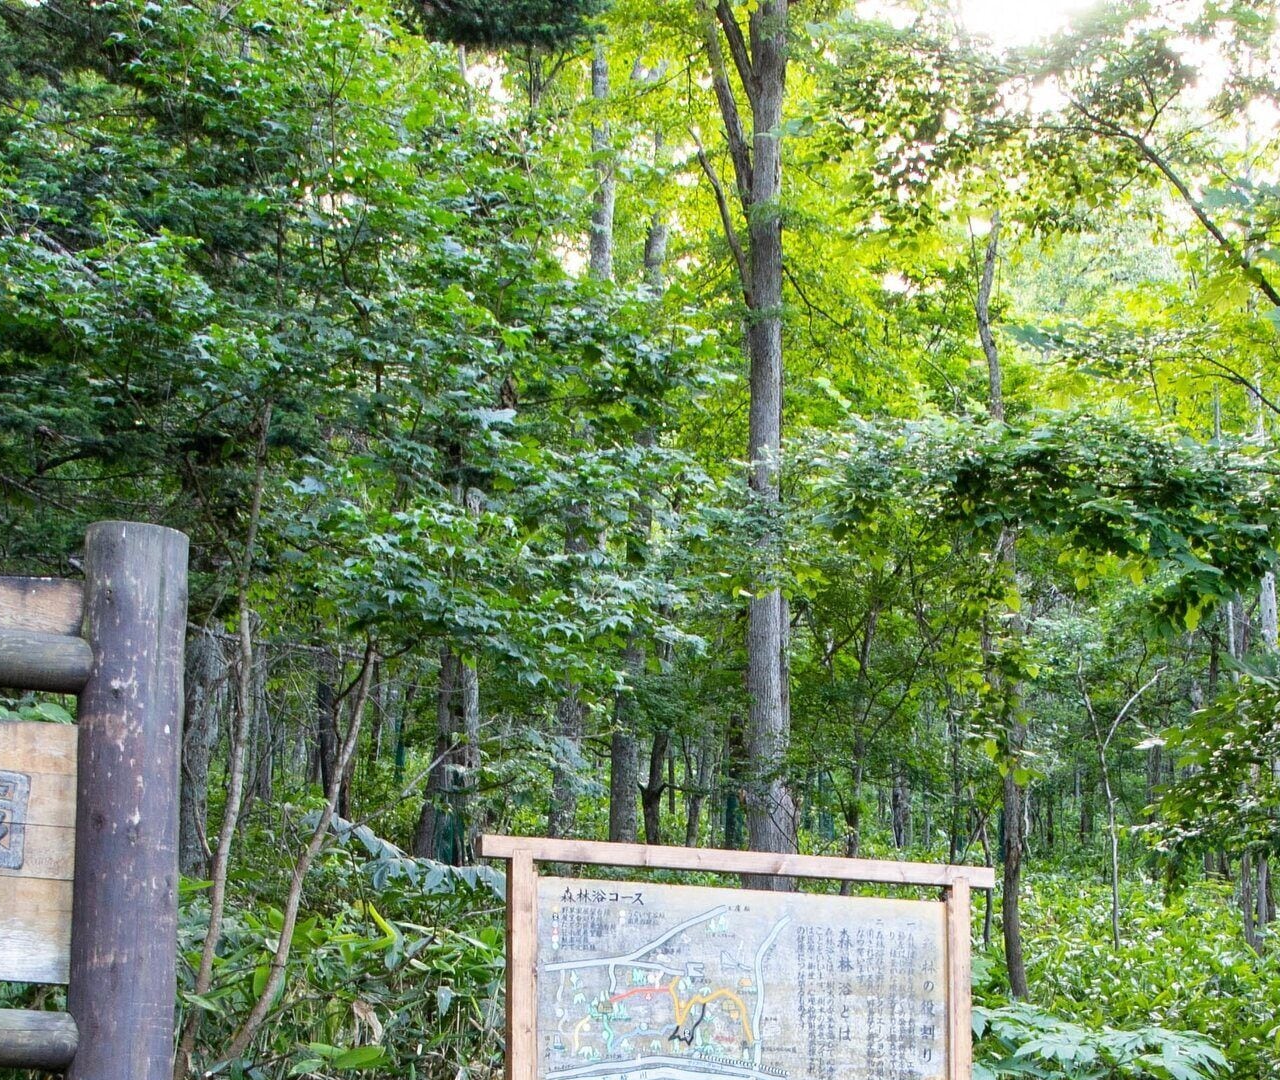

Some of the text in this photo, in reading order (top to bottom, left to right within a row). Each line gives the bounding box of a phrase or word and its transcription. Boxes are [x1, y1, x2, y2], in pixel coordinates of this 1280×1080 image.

[561, 886, 644, 906] 森林浴コース
[837, 928, 854, 1042] 森林浴とは
